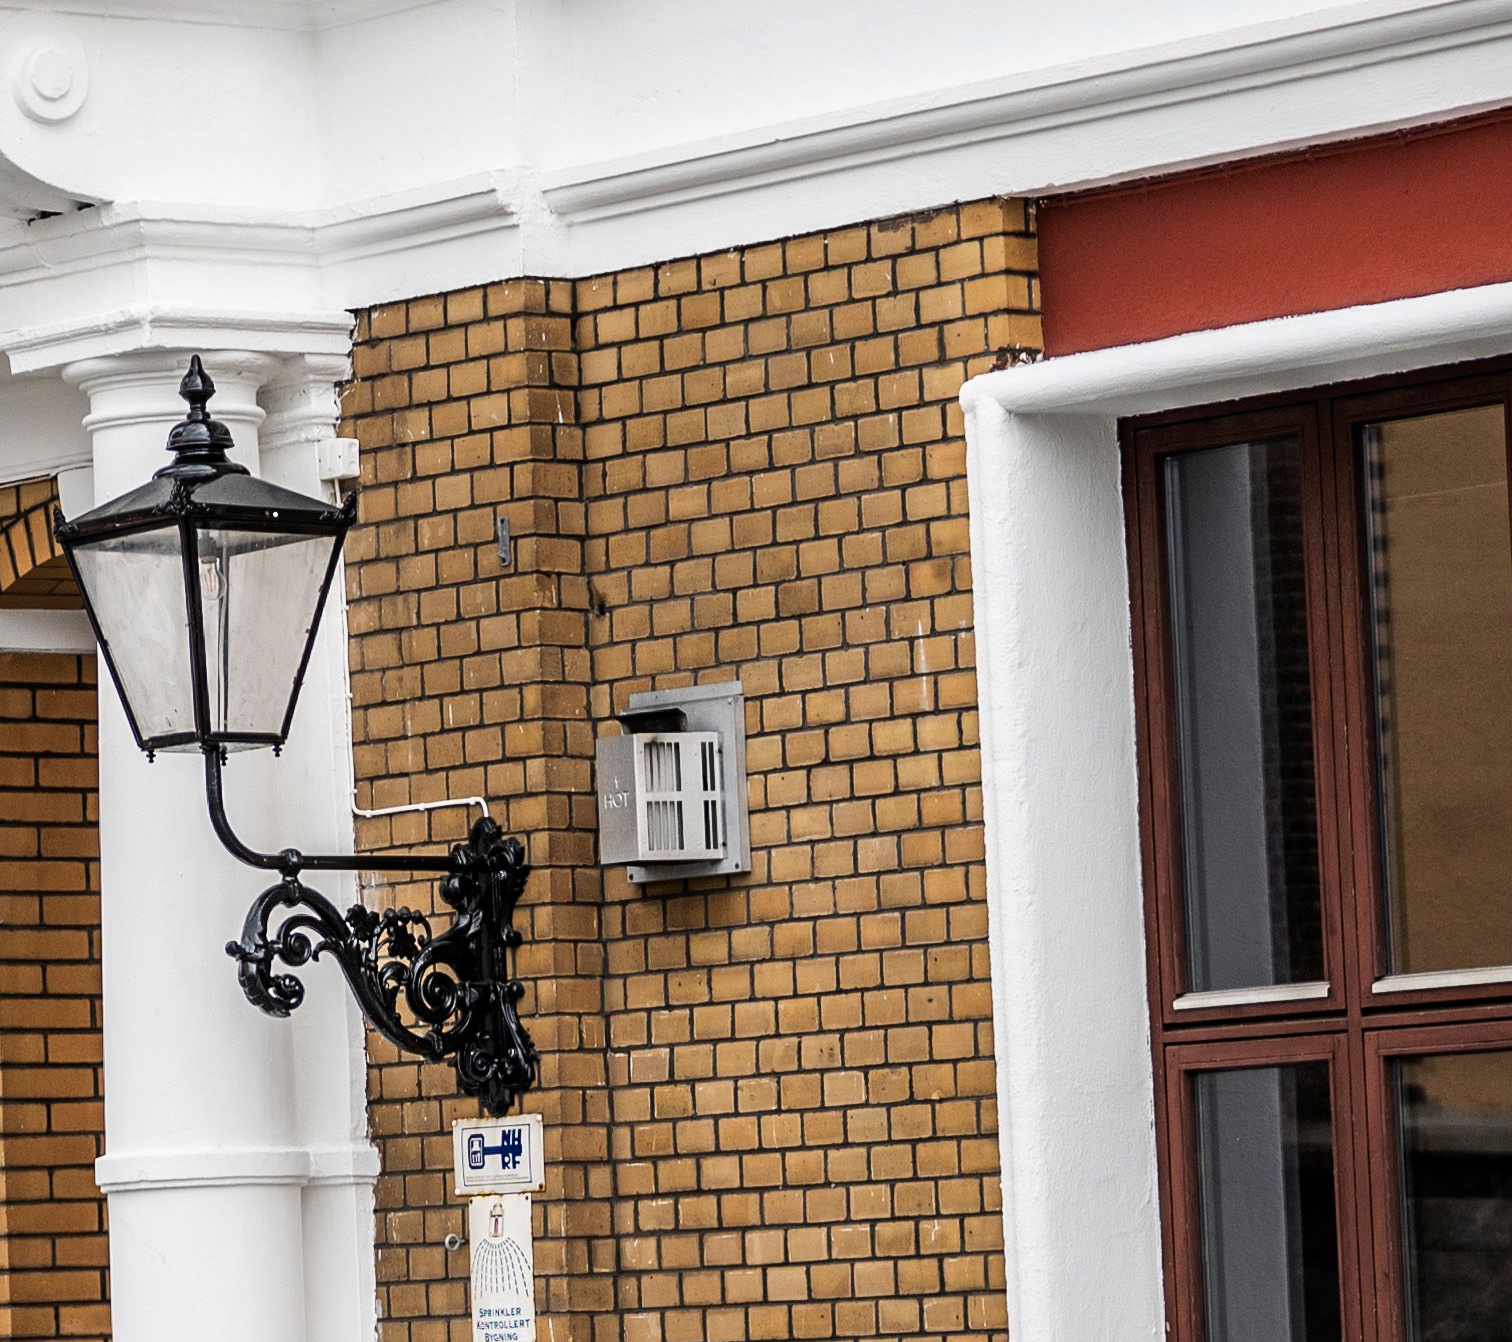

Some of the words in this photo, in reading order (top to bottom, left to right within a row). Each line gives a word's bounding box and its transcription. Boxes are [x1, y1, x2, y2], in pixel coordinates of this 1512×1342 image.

[604, 791, 629, 809] HOT
[479, 1307, 522, 1317] SPRINKLER
[484, 1332, 518, 1342] BYGNING
